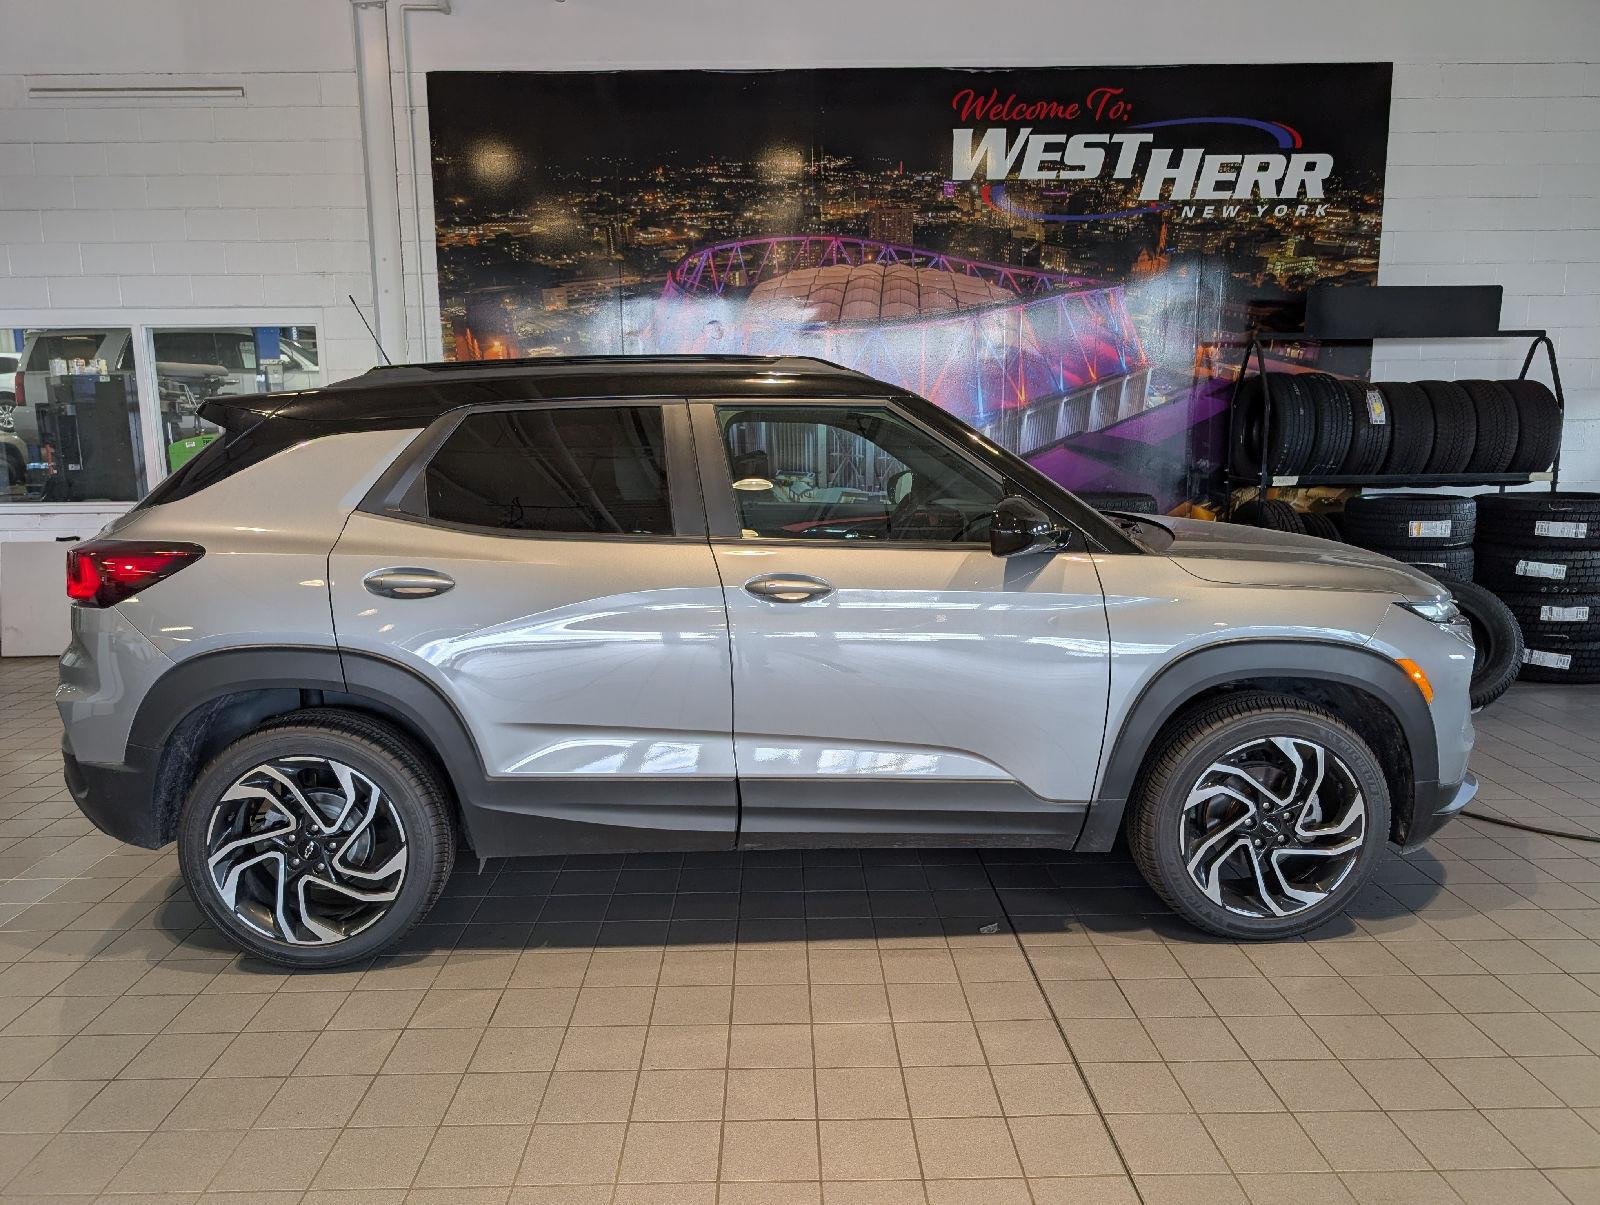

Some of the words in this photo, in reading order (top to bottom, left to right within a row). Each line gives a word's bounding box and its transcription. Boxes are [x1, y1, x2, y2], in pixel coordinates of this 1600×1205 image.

[952, 88, 1081, 122] Welcome
[1087, 87, 1133, 121] To:
[952, 127, 1153, 181] WEST
[1138, 148, 1334, 201] HERR
[1181, 205, 1240, 218] NEW
[1256, 203, 1329, 217] YORK
